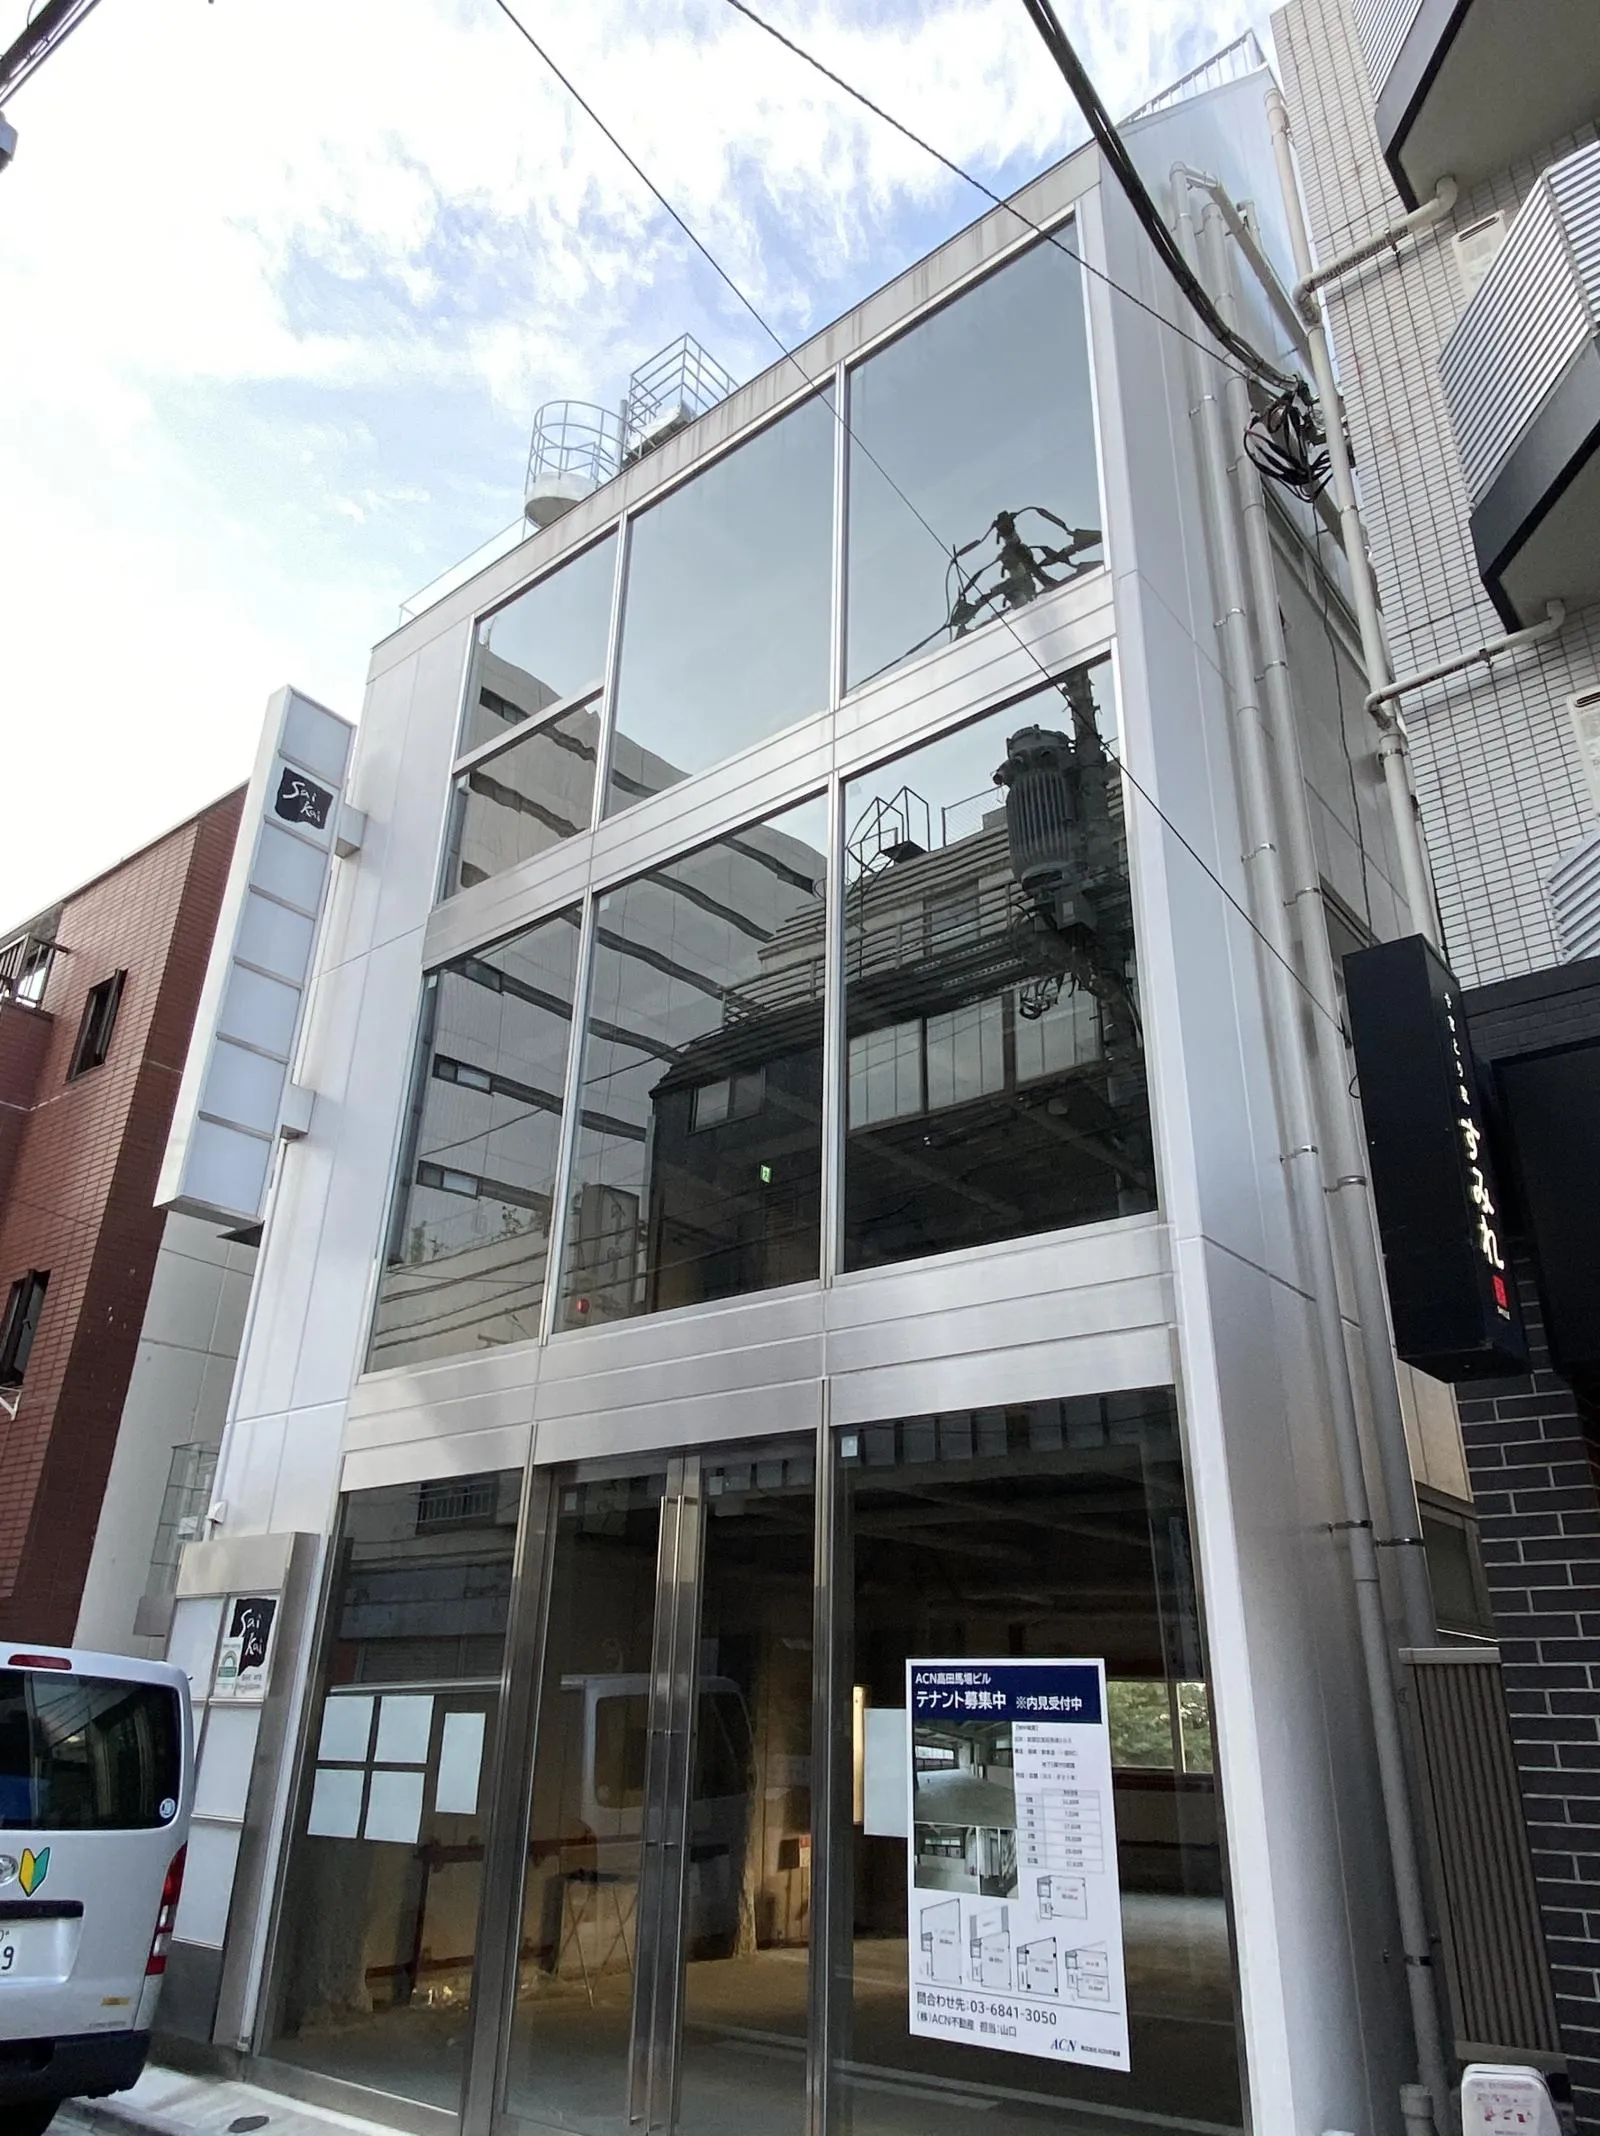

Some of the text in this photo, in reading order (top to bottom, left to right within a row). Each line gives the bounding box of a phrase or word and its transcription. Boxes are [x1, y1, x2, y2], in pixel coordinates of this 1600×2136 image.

[1458, 1117, 1505, 1271] すみれ
[914, 1672, 992, 1686] ACN高田馬場ビル
[916, 1690, 1007, 1711] テナント募集中
[1050, 2037, 1078, 2053] ACN
